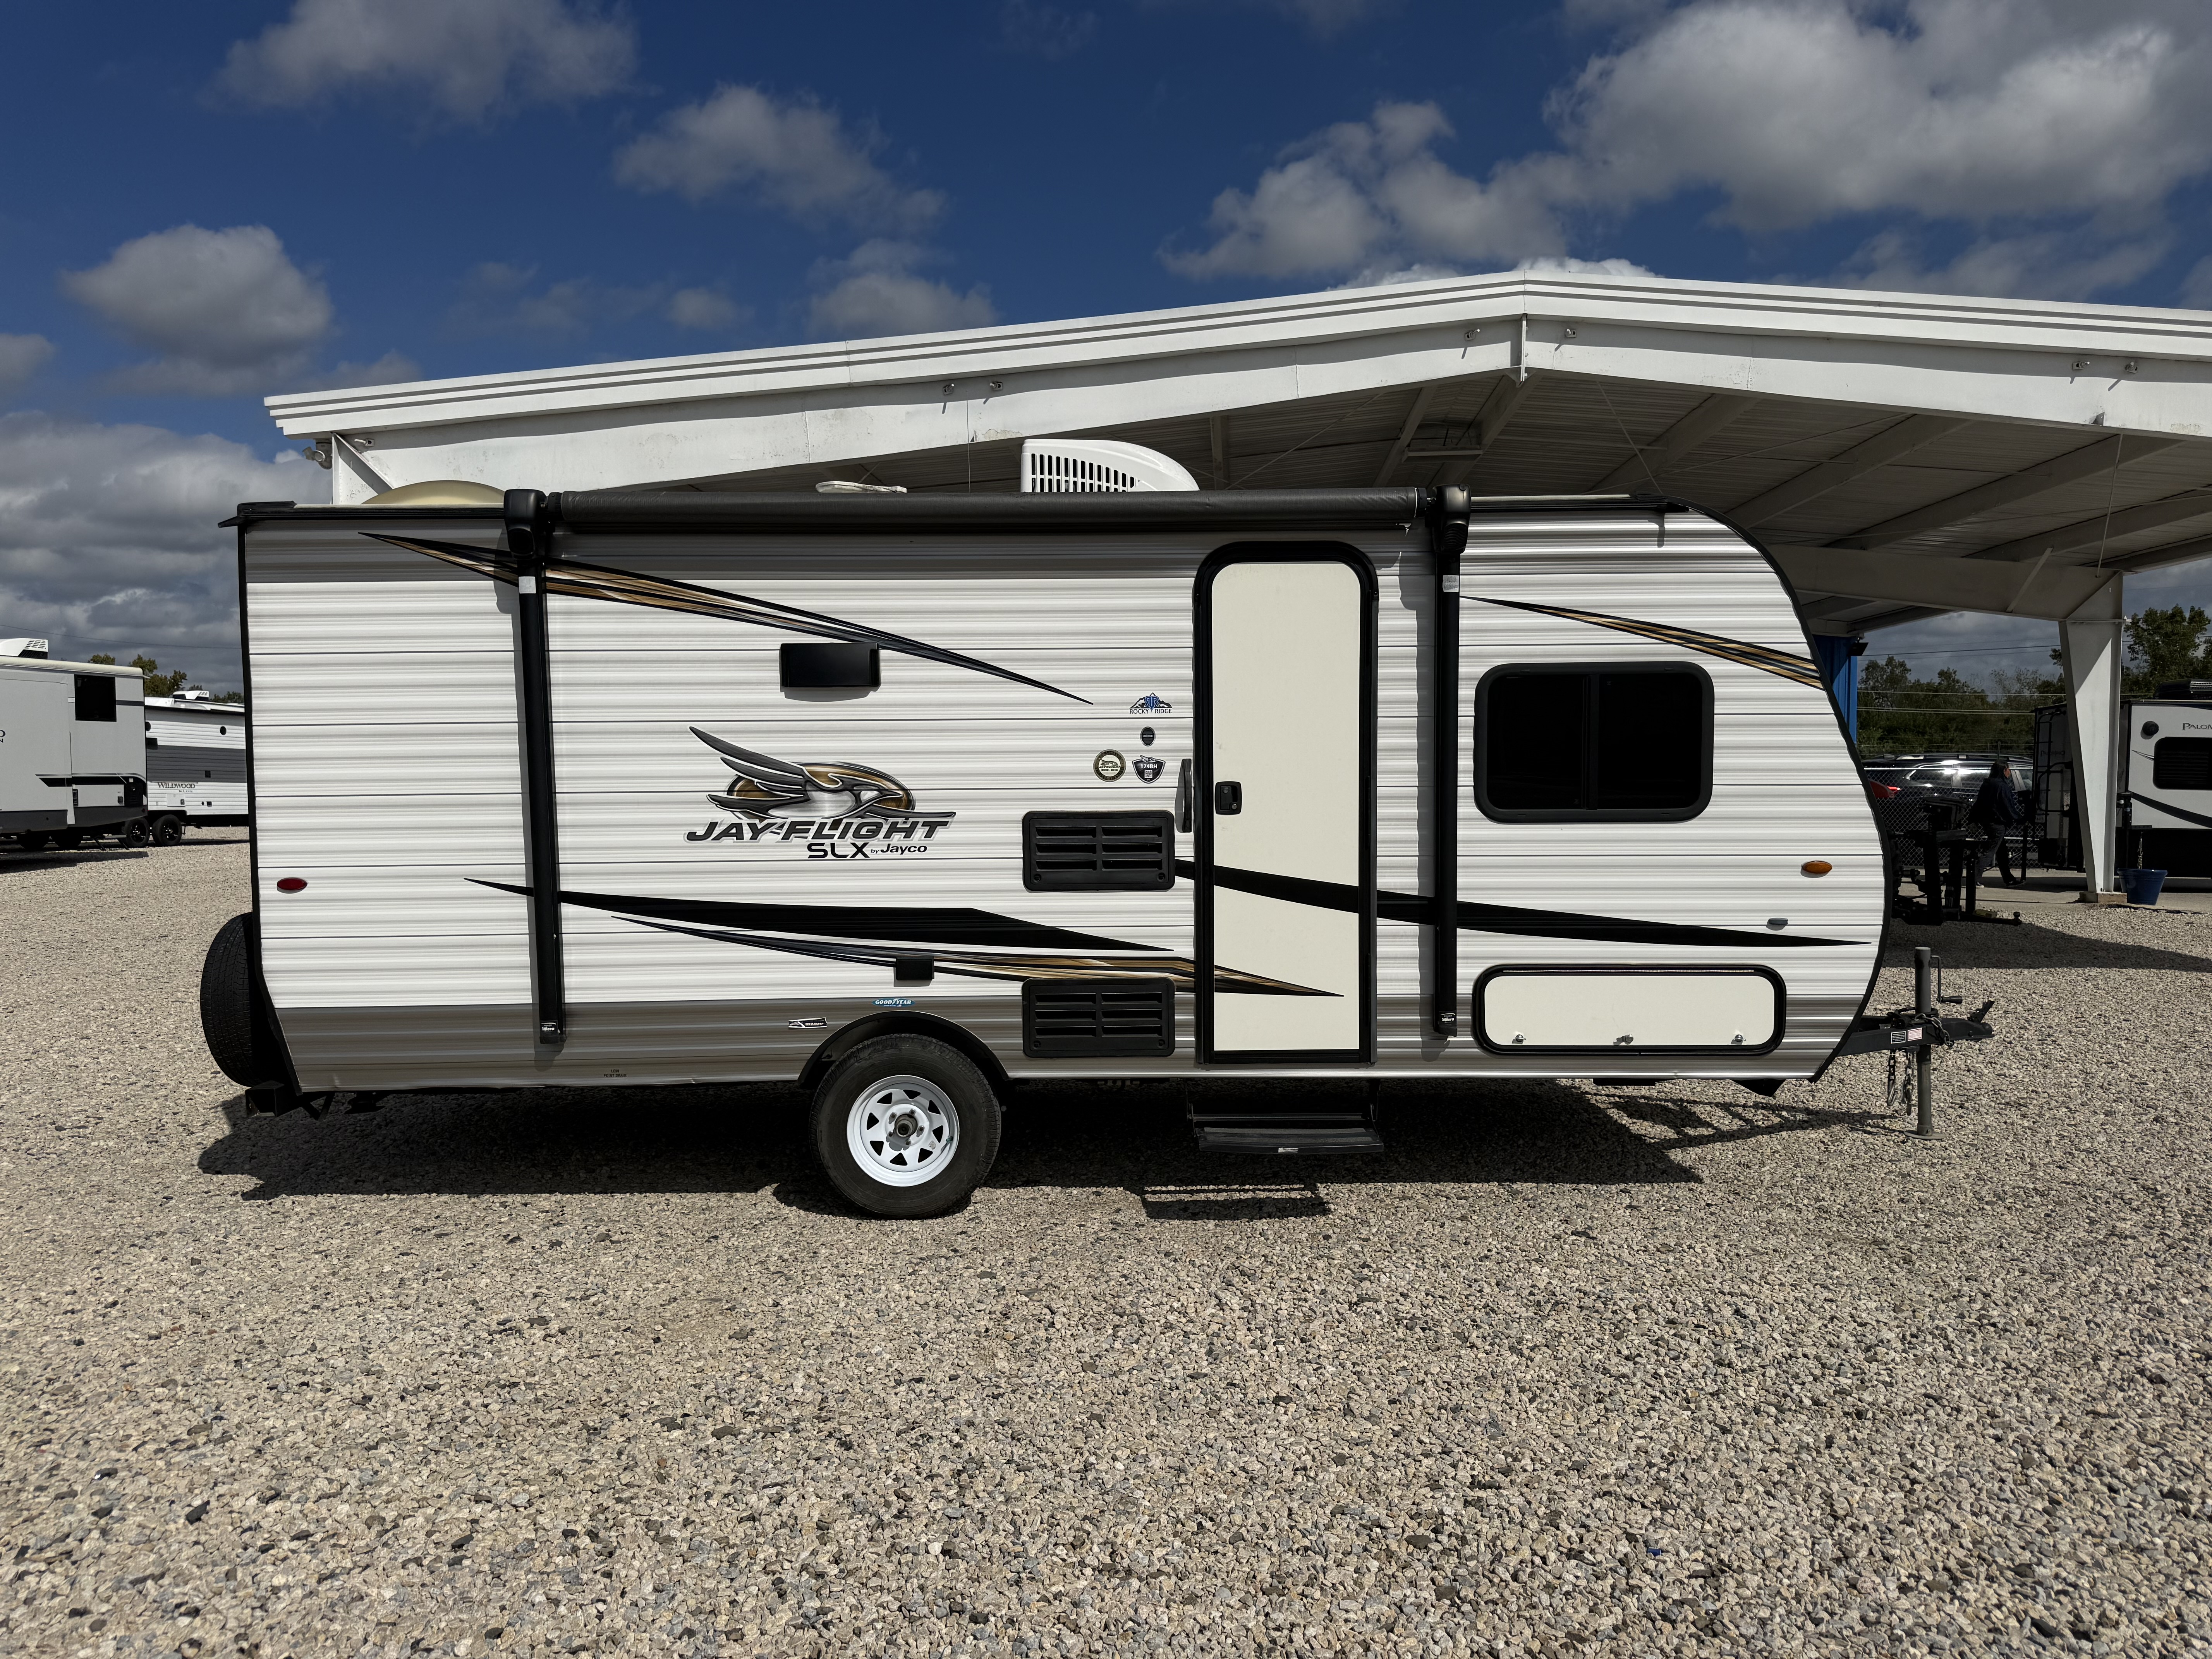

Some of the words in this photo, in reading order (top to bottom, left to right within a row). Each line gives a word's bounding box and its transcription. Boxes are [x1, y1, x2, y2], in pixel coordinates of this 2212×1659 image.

[686, 821, 775, 841] JAY
[781, 820, 948, 840] FLIGHT
[808, 842, 870, 859] SLX
[880, 843, 928, 855] Jayco
